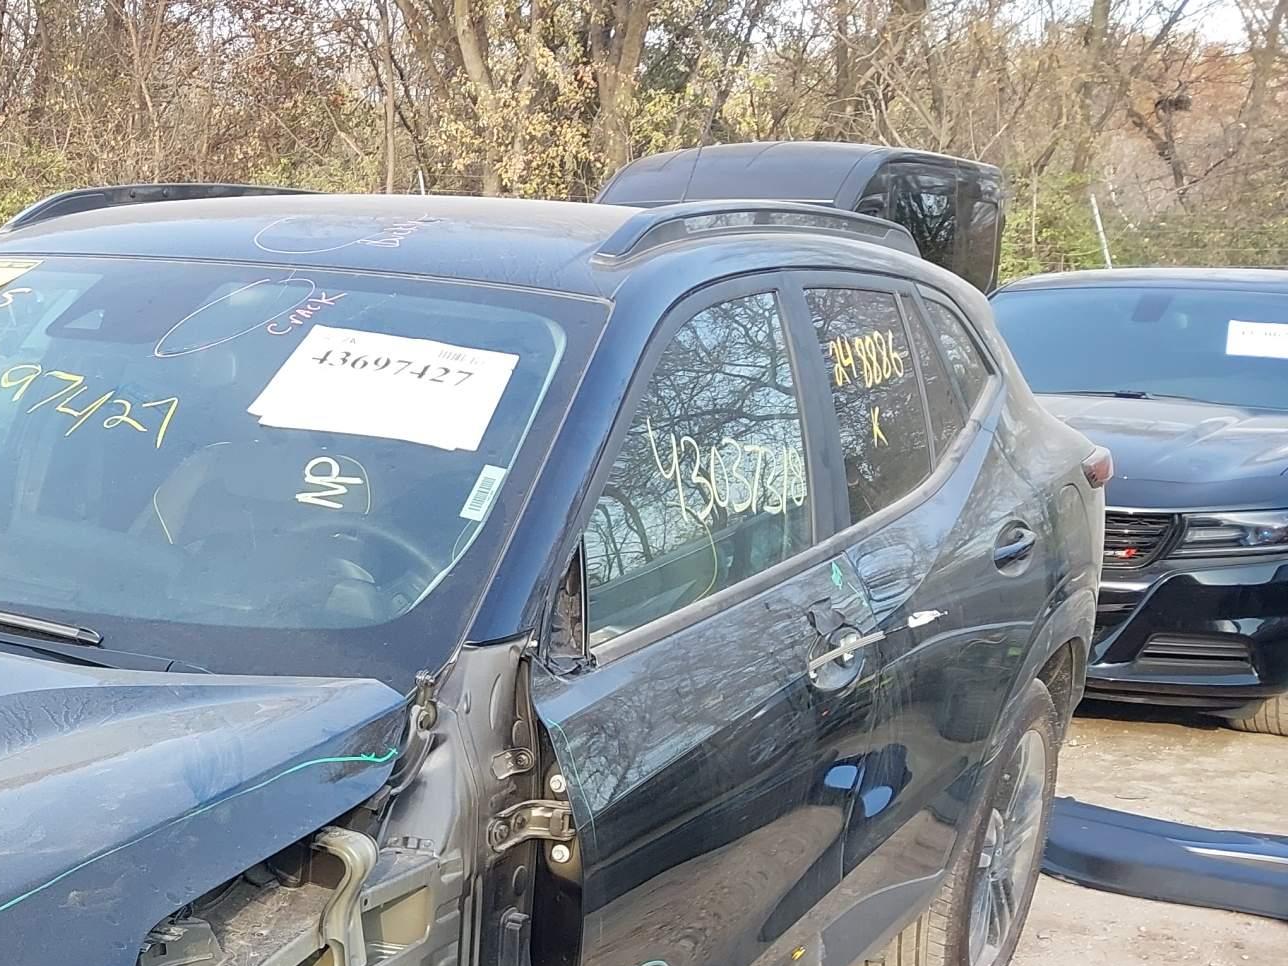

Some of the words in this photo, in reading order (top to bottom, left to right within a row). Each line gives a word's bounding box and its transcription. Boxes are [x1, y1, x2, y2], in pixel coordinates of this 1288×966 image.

[312, 350, 474, 387] 43697427
[829, 329, 904, 389] 248886
[870, 406, 889, 448] K
[646, 415, 805, 523] 43037318
